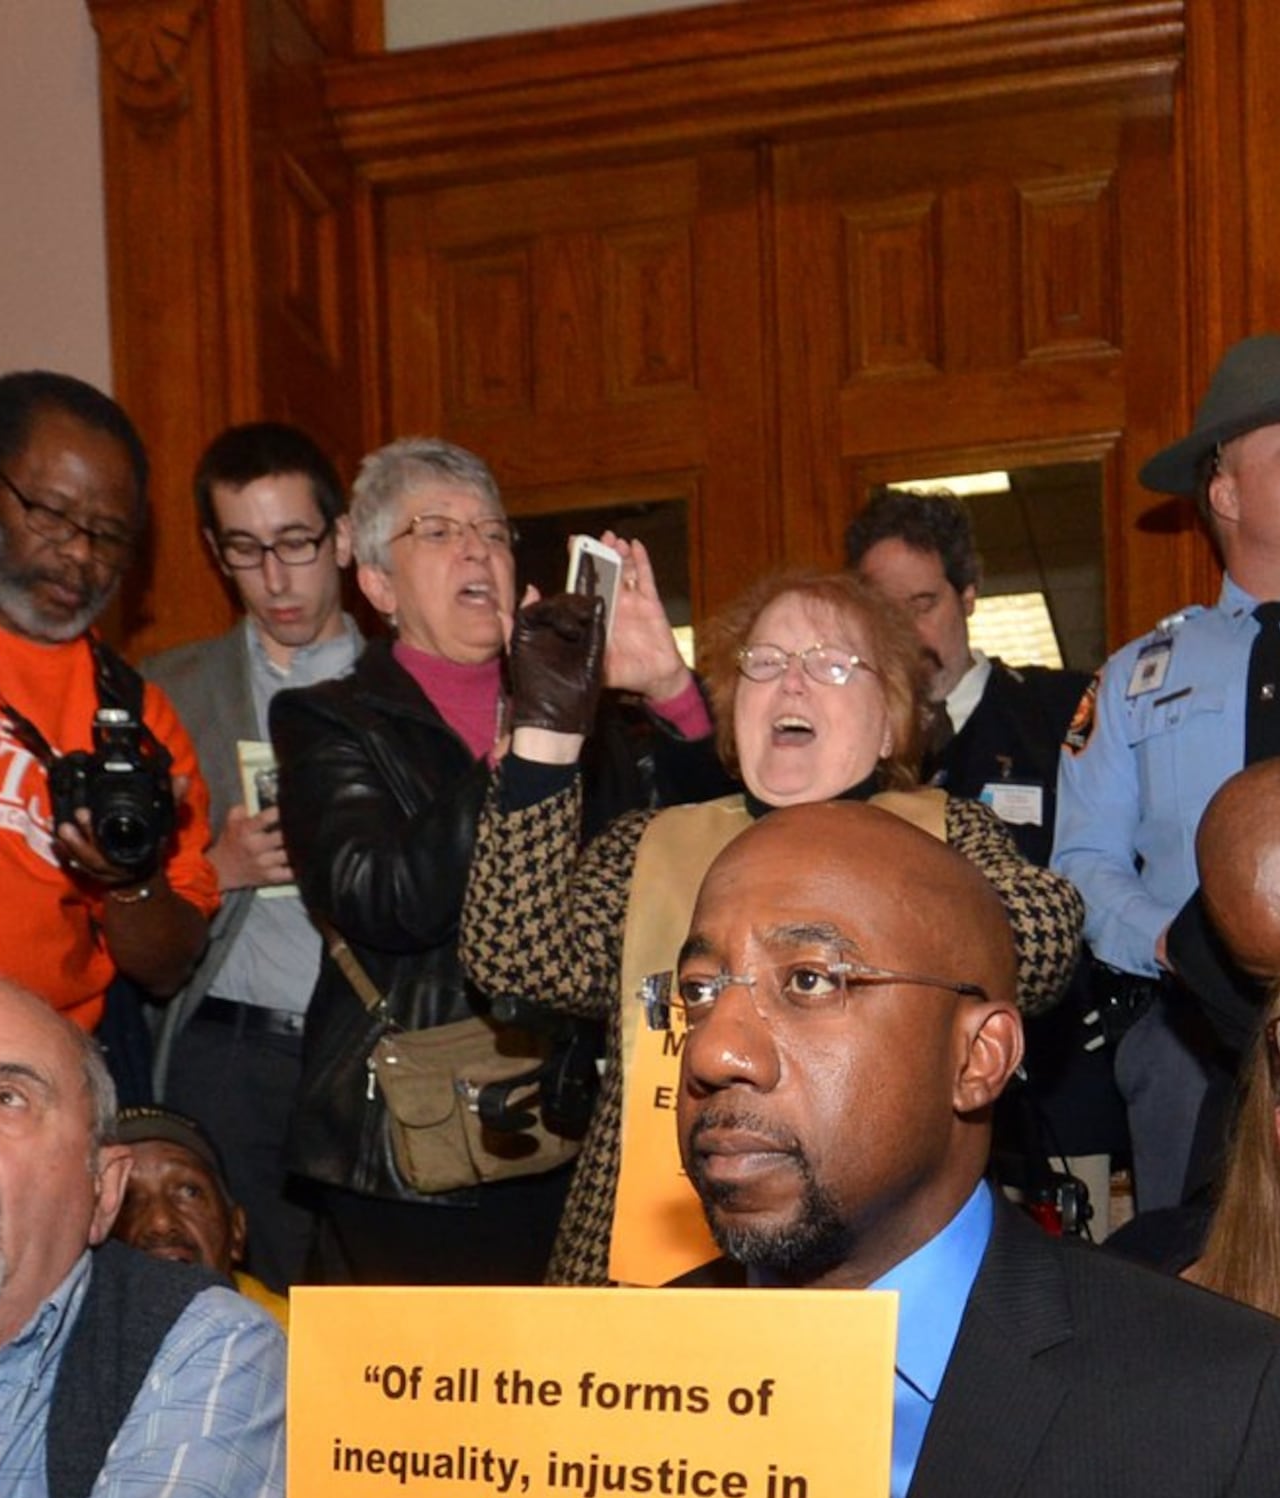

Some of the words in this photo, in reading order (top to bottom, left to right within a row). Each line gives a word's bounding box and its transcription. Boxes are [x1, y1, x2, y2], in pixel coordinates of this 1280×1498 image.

[364, 1364, 424, 1401] “Of
[433, 1367, 479, 1403] all
[493, 1369, 563, 1407] the
[577, 1371, 710, 1414] forms
[727, 1378, 776, 1417] of
[332, 1437, 531, 1494] inequality,
